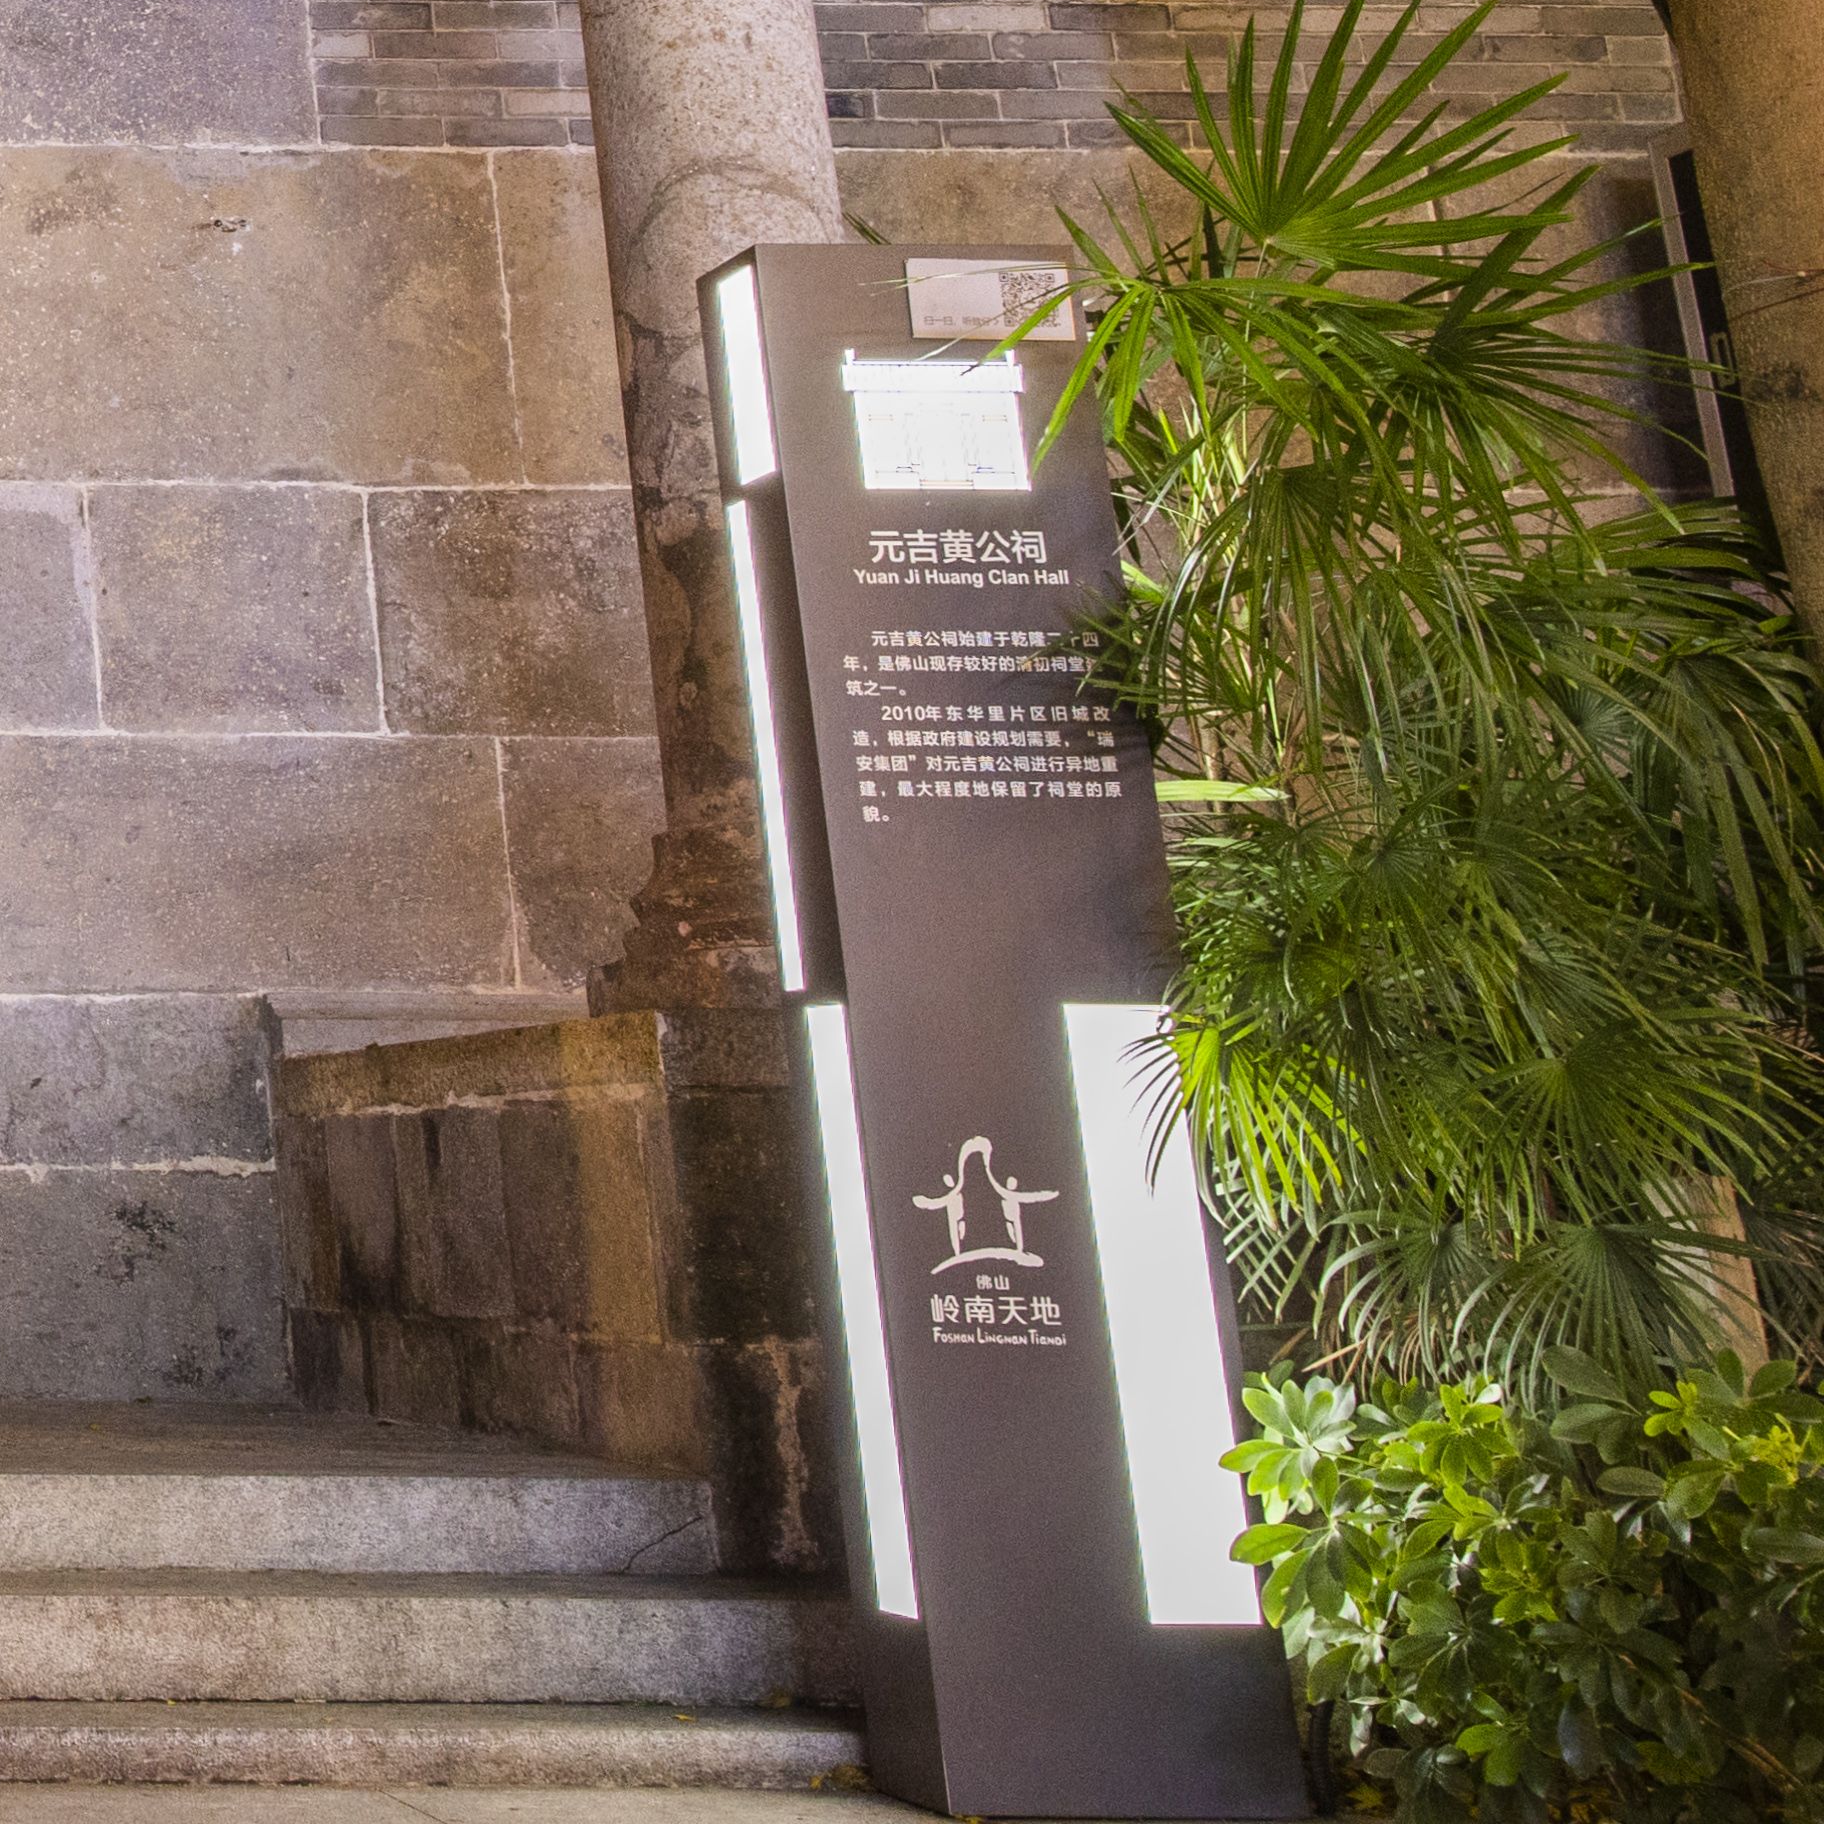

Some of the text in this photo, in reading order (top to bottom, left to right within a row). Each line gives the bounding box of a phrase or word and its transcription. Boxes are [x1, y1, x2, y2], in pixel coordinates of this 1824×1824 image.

[869, 529, 1047, 564] 元吉黄公祠
[854, 569, 1070, 588] Yuan Ji Huang Clan Hall
[846, 680, 906, 697] 筑之一。
[862, 805, 890, 823] 貌。
[976, 1274, 1010, 1290] 佛山
[931, 1294, 1062, 1326] 岭南天地
